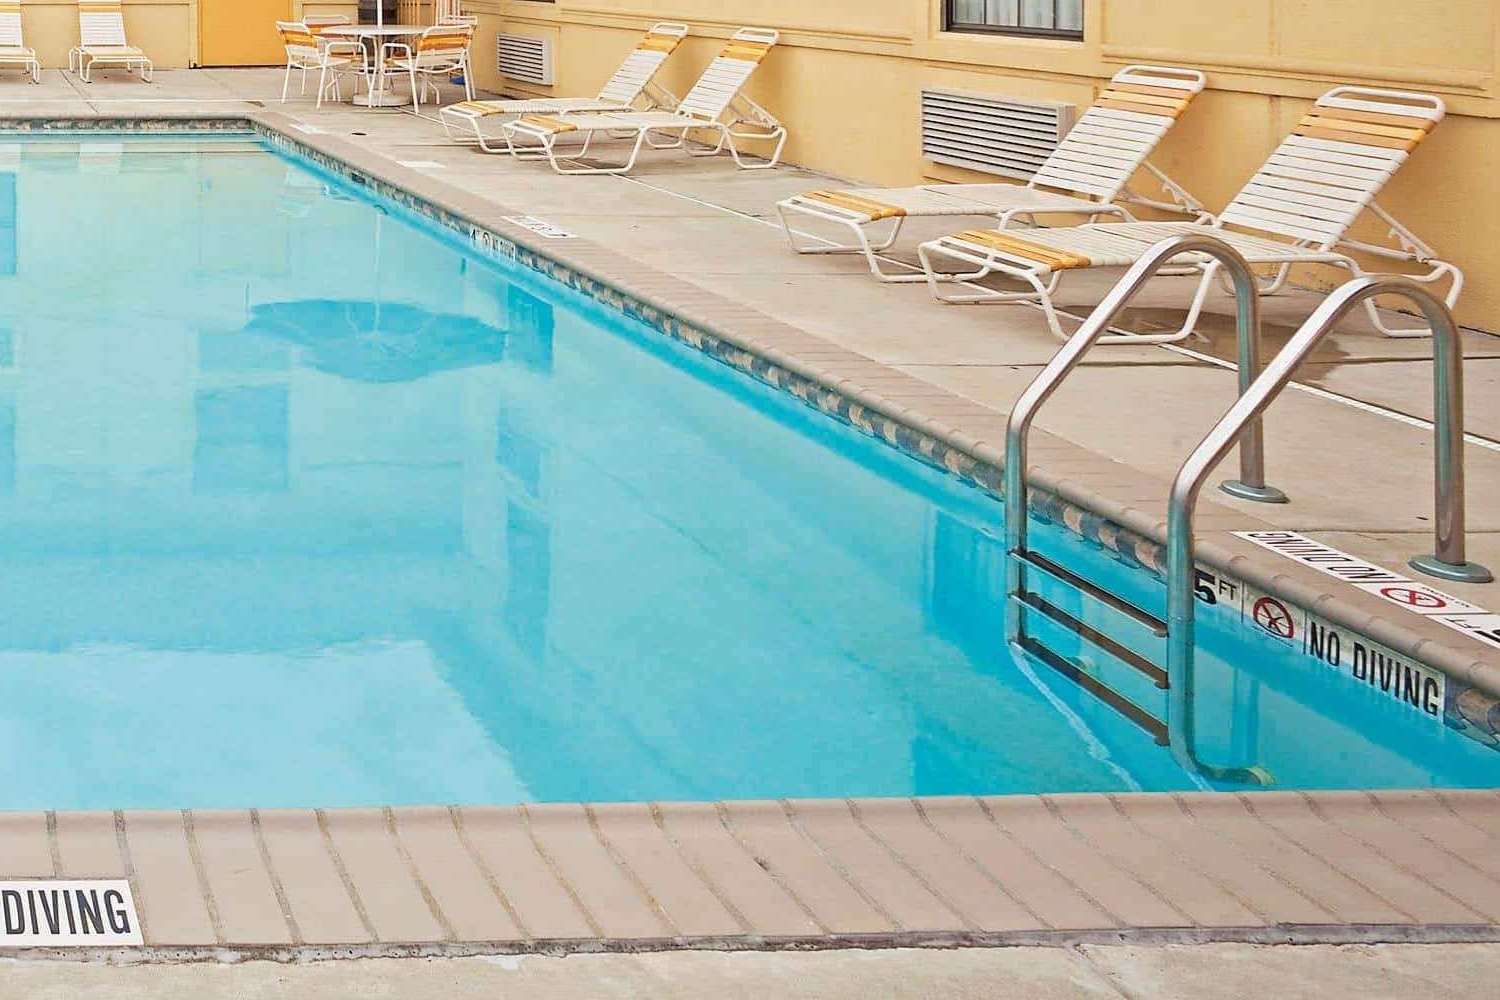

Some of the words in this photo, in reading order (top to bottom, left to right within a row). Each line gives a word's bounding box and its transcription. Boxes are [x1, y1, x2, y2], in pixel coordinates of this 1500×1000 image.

[1248, 533, 1354, 562] DIVING
[1194, 567, 1217, 605] 5
[1219, 579, 1237, 601] FT
[1327, 566, 1397, 579] NO
[1310, 621, 1341, 667] NO
[1353, 641, 1439, 717] DIVING
[1, 889, 131, 935] DIVING
